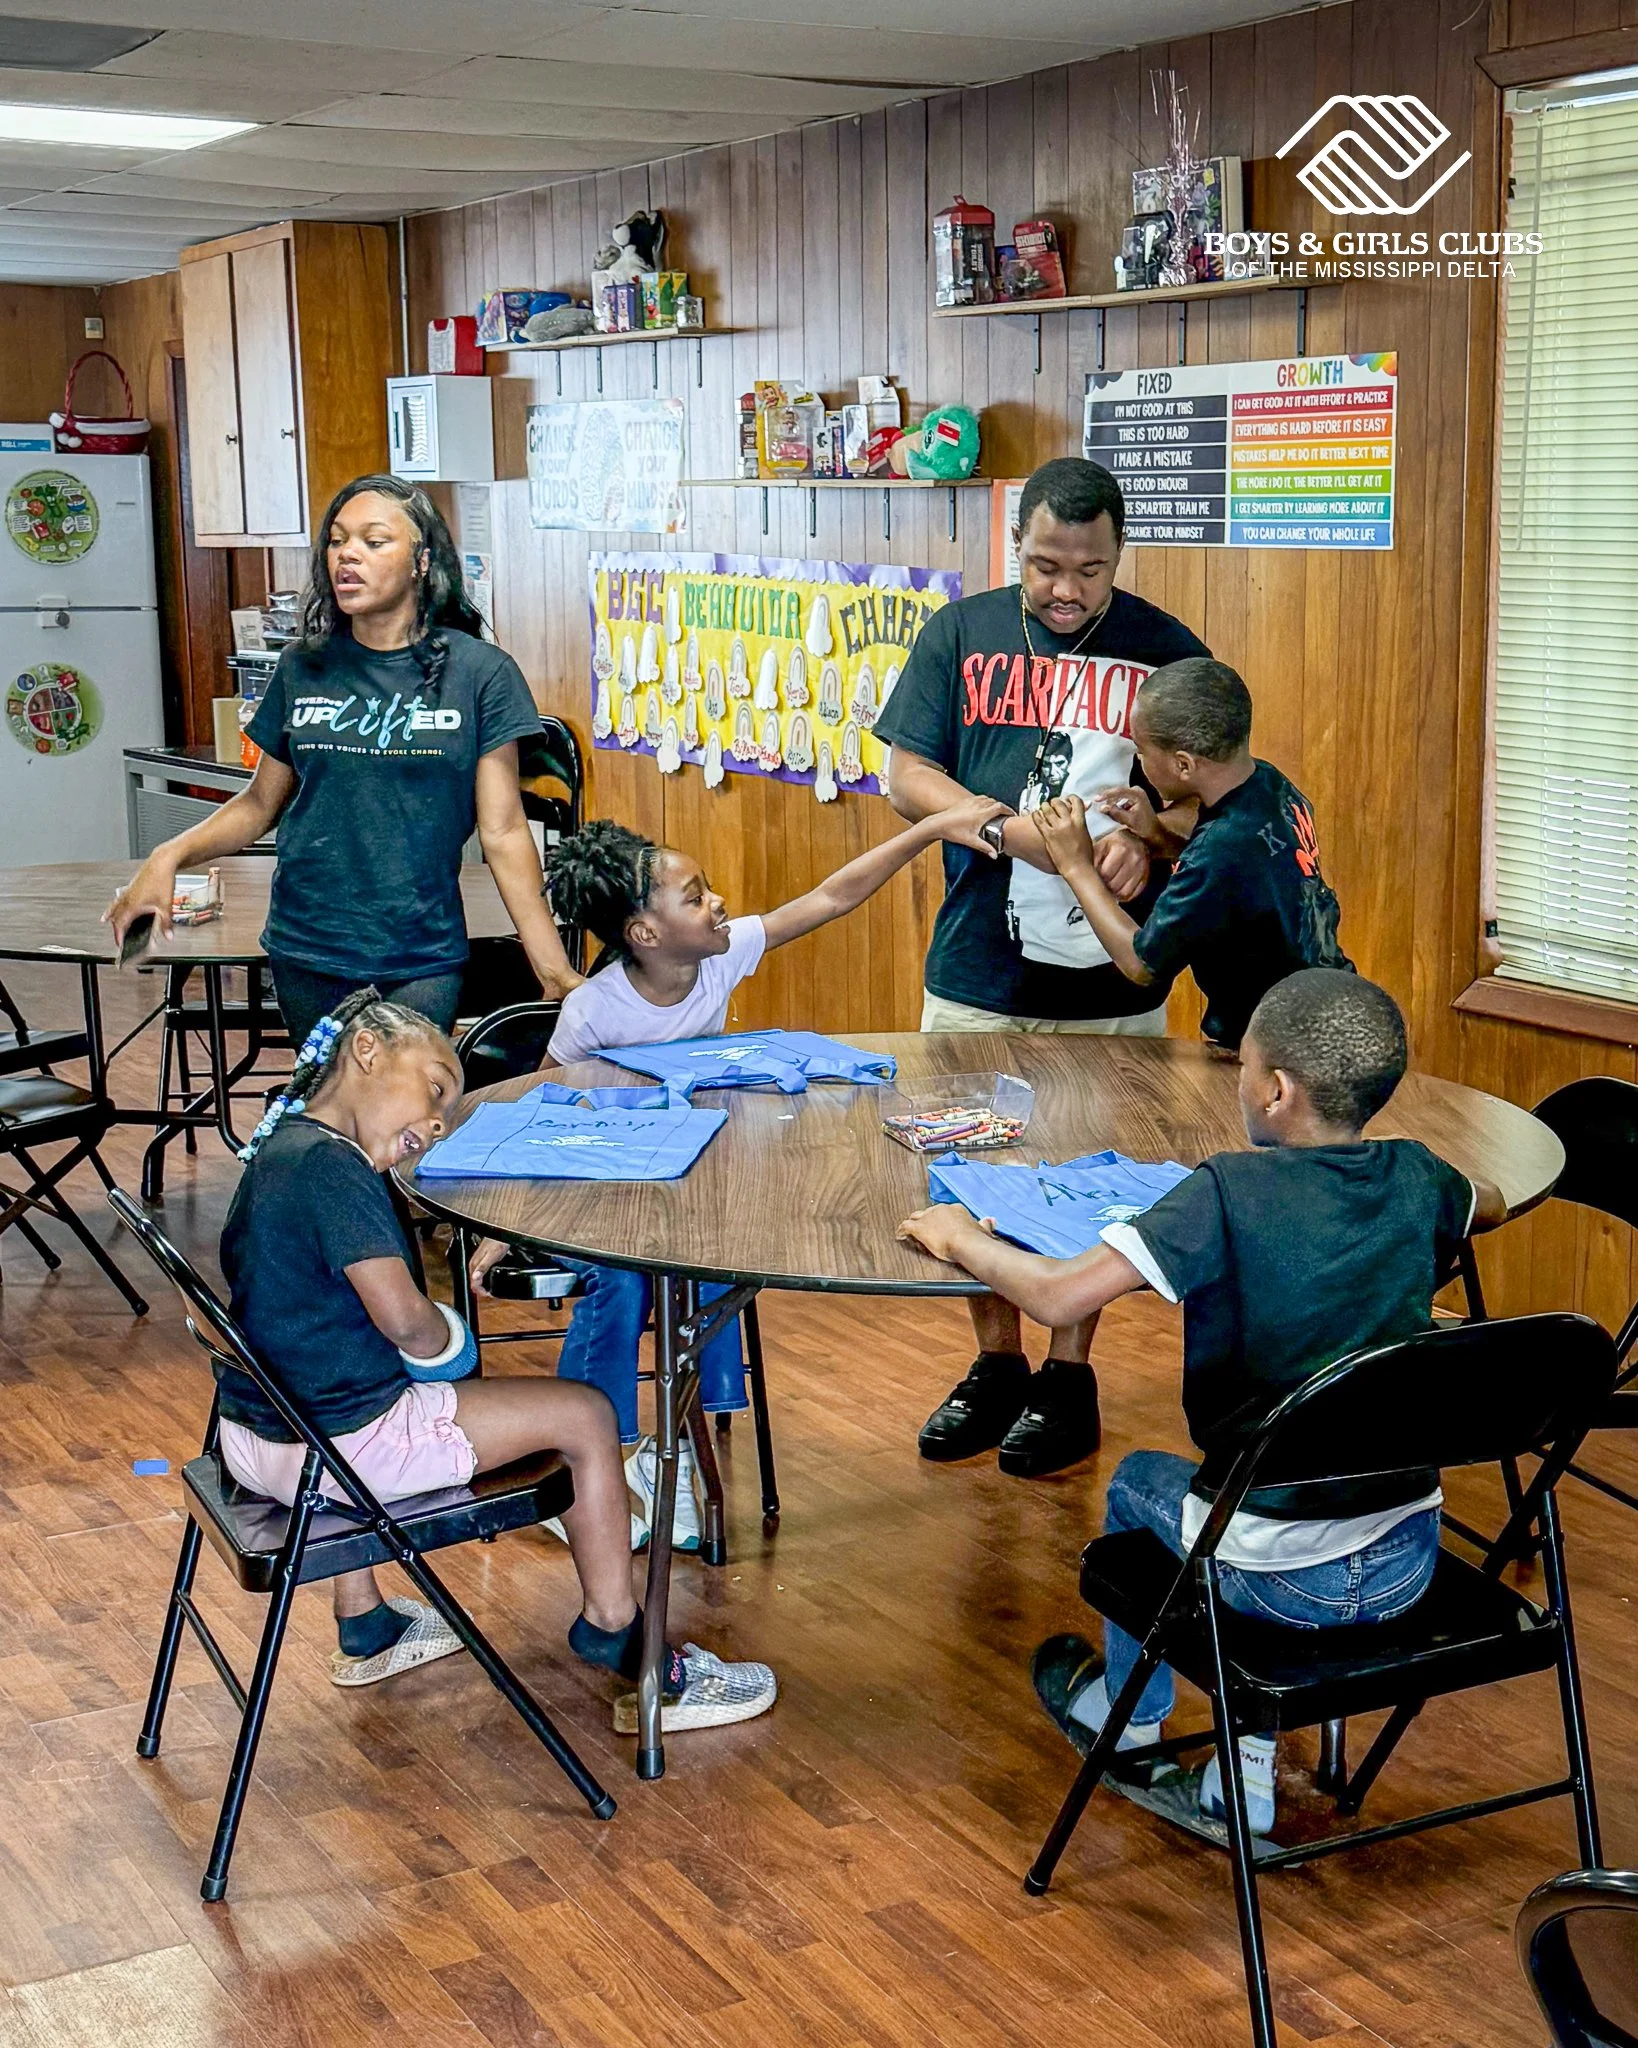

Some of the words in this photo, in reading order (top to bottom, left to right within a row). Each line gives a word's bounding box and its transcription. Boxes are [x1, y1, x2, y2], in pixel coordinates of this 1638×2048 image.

[1277, 360, 1343, 388] GROWTH
[1137, 372, 1172, 396] FIXED
[1237, 399, 1251, 410] CAN
[1251, 398, 1263, 409] GET
[1264, 396, 1283, 409] GOOD
[1284, 396, 1294, 408] AT
[1294, 396, 1301, 407] IT
[1301, 395, 1319, 407] WITH
[1319, 393, 1345, 406] EFFORT
[1346, 393, 1352, 404] &
[1353, 391, 1388, 404] PRACTICE
[1126, 403, 1141, 417] NOT
[1142, 402, 1163, 417] GOOD
[1164, 402, 1175, 416] AT
[1176, 401, 1194, 415] THIS
[1118, 428, 1135, 442] THIS
[1137, 427, 1145, 441] IS
[1147, 426, 1165, 441] TOO
[1166, 426, 1190, 440] HARD
[1235, 423, 1279, 437] EVERYTHING
[1279, 422, 1289, 435] IS
[1289, 421, 1312, 435] HARD
[1312, 420, 1342, 434] BEFORE
[1342, 419, 1351, 433] IT
[1352, 419, 1362, 432] IS
[1363, 417, 1387, 432] EASY
[529, 423, 577, 453] CHANGE
[624, 420, 679, 451] CHANGE
[1113, 453, 1118, 468] I
[1119, 451, 1143, 468] MADE
[1143, 451, 1152, 467] A
[1153, 450, 1193, 467] MISTAKE
[1268, 449, 1286, 462] HELP
[1287, 448, 1297, 461] ME
[1310, 448, 1319, 460] IT
[1319, 447, 1347, 460] BETTER
[1348, 446, 1370, 460] NEXT
[1371, 446, 1389, 459] TIME
[1133, 477, 1156, 491] GOOD
[1157, 477, 1188, 491] ENOUGH
[1236, 477, 1248, 489] THE
[1248, 476, 1268, 489] MORE
[1272, 476, 1283, 489] DO
[1293, 476, 1307, 489] THE
[1307, 475, 1333, 489] BETTER
[1347, 475, 1363, 487] GET
[1363, 475, 1374, 487] AT
[1374, 475, 1383, 487] IT
[1135, 501, 1173, 516] SMARTER
[1175, 502, 1198, 516] THAN
[1199, 502, 1210, 515] ME
[1239, 503, 1251, 514] GET
[1251, 502, 1284, 515] SMARTER
[1284, 502, 1294, 514] BY
[1295, 502, 1329, 515] LEARNING
[1329, 502, 1350, 514] MORE
[1351, 501, 1376, 514] ABOUT
[1377, 501, 1386, 514] IT
[1126, 526, 1152, 539] CHANGE
[1153, 525, 1174, 539] YOUR
[1175, 525, 1205, 539] MINDSET
[1242, 527, 1259, 540] YOU
[1259, 527, 1276, 540] CAN
[1276, 527, 1307, 541] CHANGE
[1308, 527, 1331, 541] YOUR
[1332, 527, 1360, 542] WHOLE
[1360, 528, 1376, 542] LIFE
[607, 571, 666, 625] BGC
[684, 580, 803, 640] BEHAVIOR
[336, 745, 366, 754] VOICES
